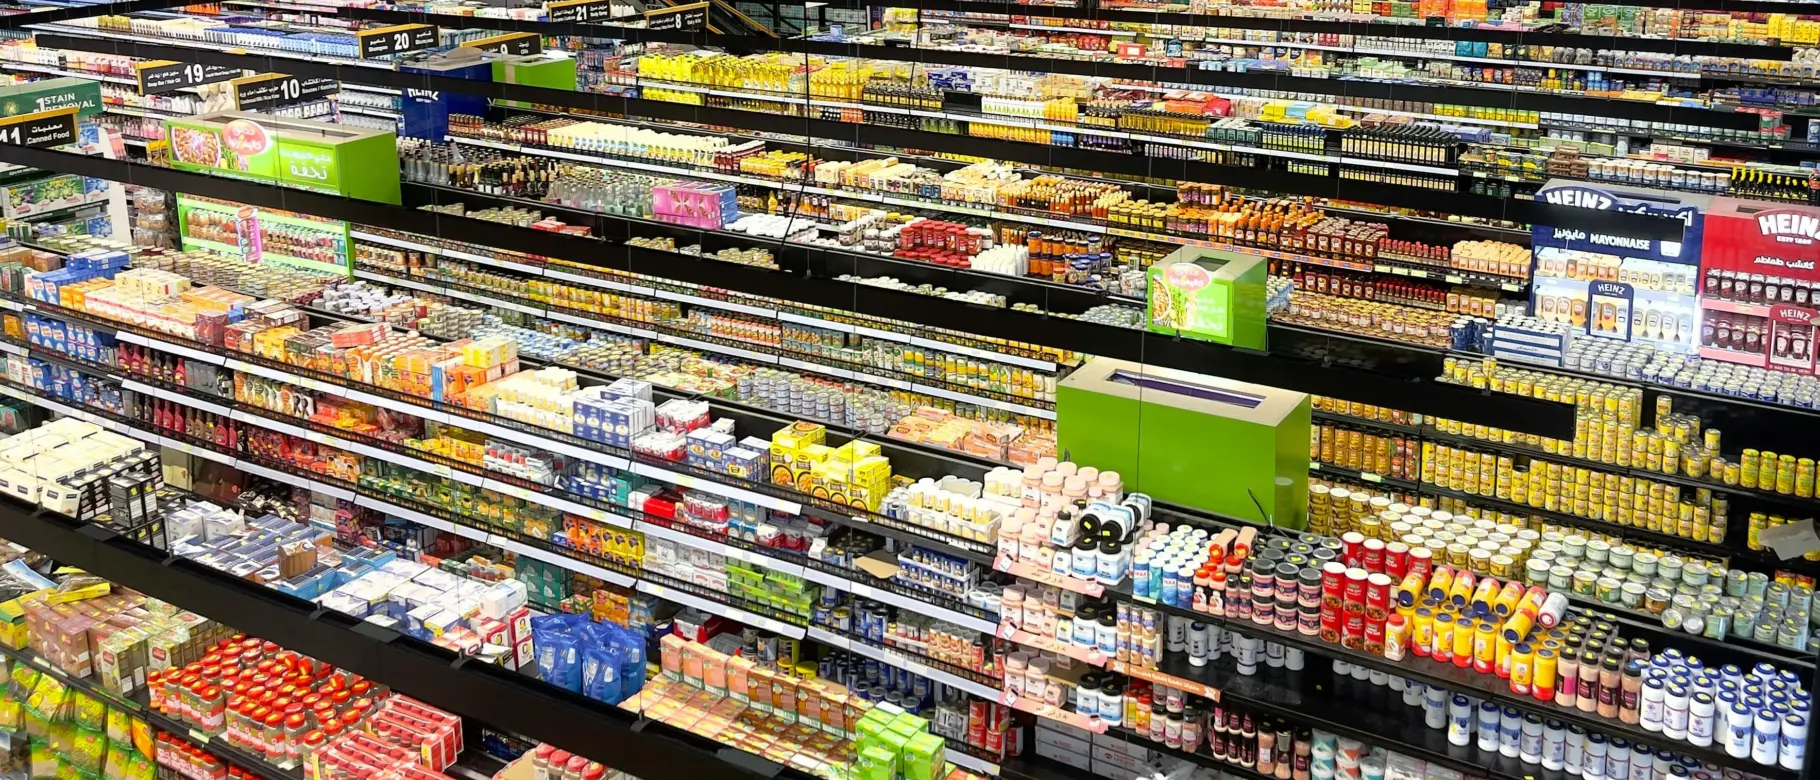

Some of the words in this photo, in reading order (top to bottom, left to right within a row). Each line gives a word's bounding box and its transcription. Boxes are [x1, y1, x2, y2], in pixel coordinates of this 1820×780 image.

[575, 5, 587, 21] 21
[675, 13, 682, 29] 8
[393, 32, 409, 50] 20
[183, 64, 203, 83] 19
[281, 78, 299, 99] 10
[45, 93, 75, 105] STAIN
[27, 134, 52, 144] Canned
[53, 130, 70, 139] Food
[1590, 233, 1650, 251] MAYONNAISE
[1597, 284, 1625, 295] HEINZ
[1780, 309, 1810, 322] HEINZ
